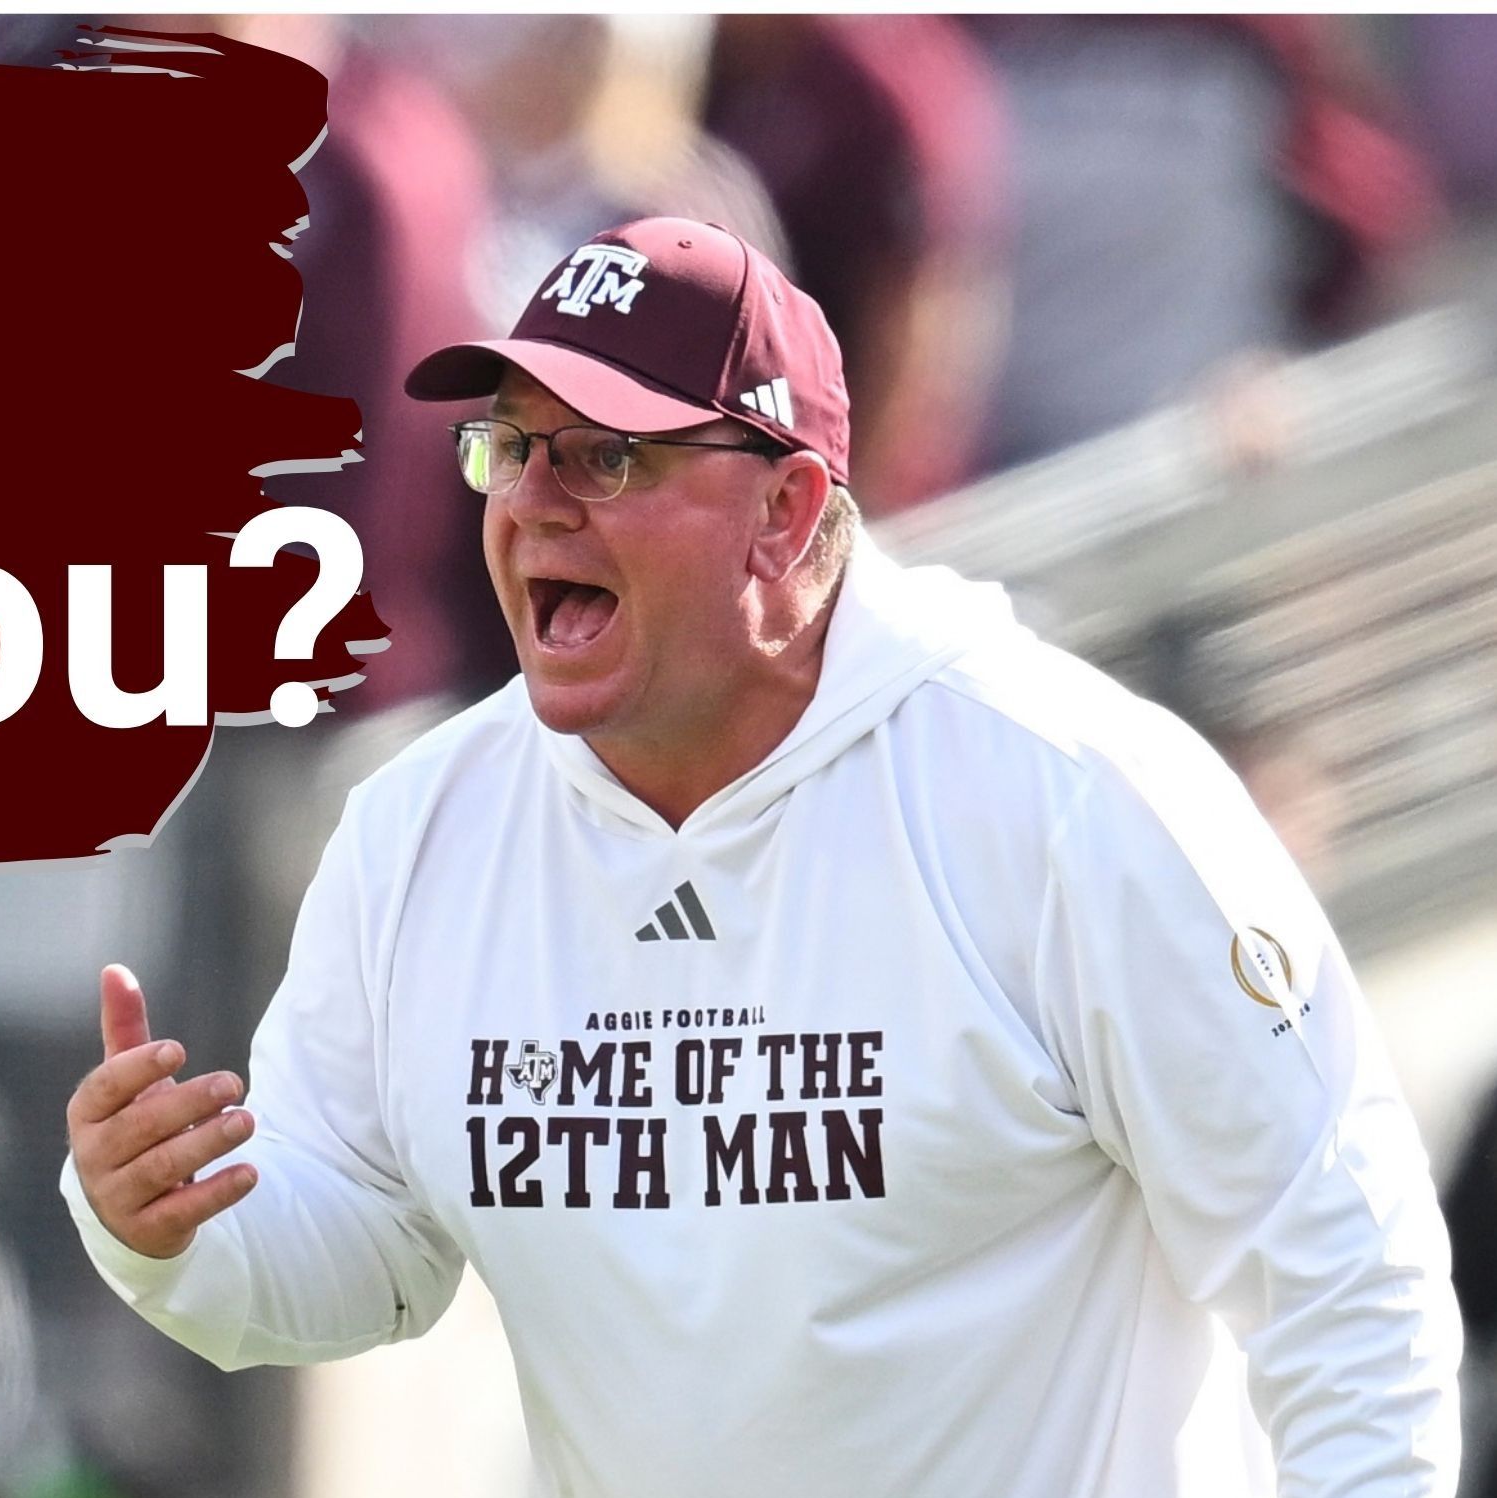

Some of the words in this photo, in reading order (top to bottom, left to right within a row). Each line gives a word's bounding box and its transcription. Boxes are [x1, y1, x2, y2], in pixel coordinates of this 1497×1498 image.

[585, 1011, 653, 1031] AGGIE
[663, 1005, 765, 1028] FOOTBALL
[466, 1039, 652, 1107] HME
[675, 1038, 742, 1105] OF
[757, 1031, 883, 1100] THE
[466, 1116, 670, 1209] 12TH
[703, 1108, 886, 1207] MAN
